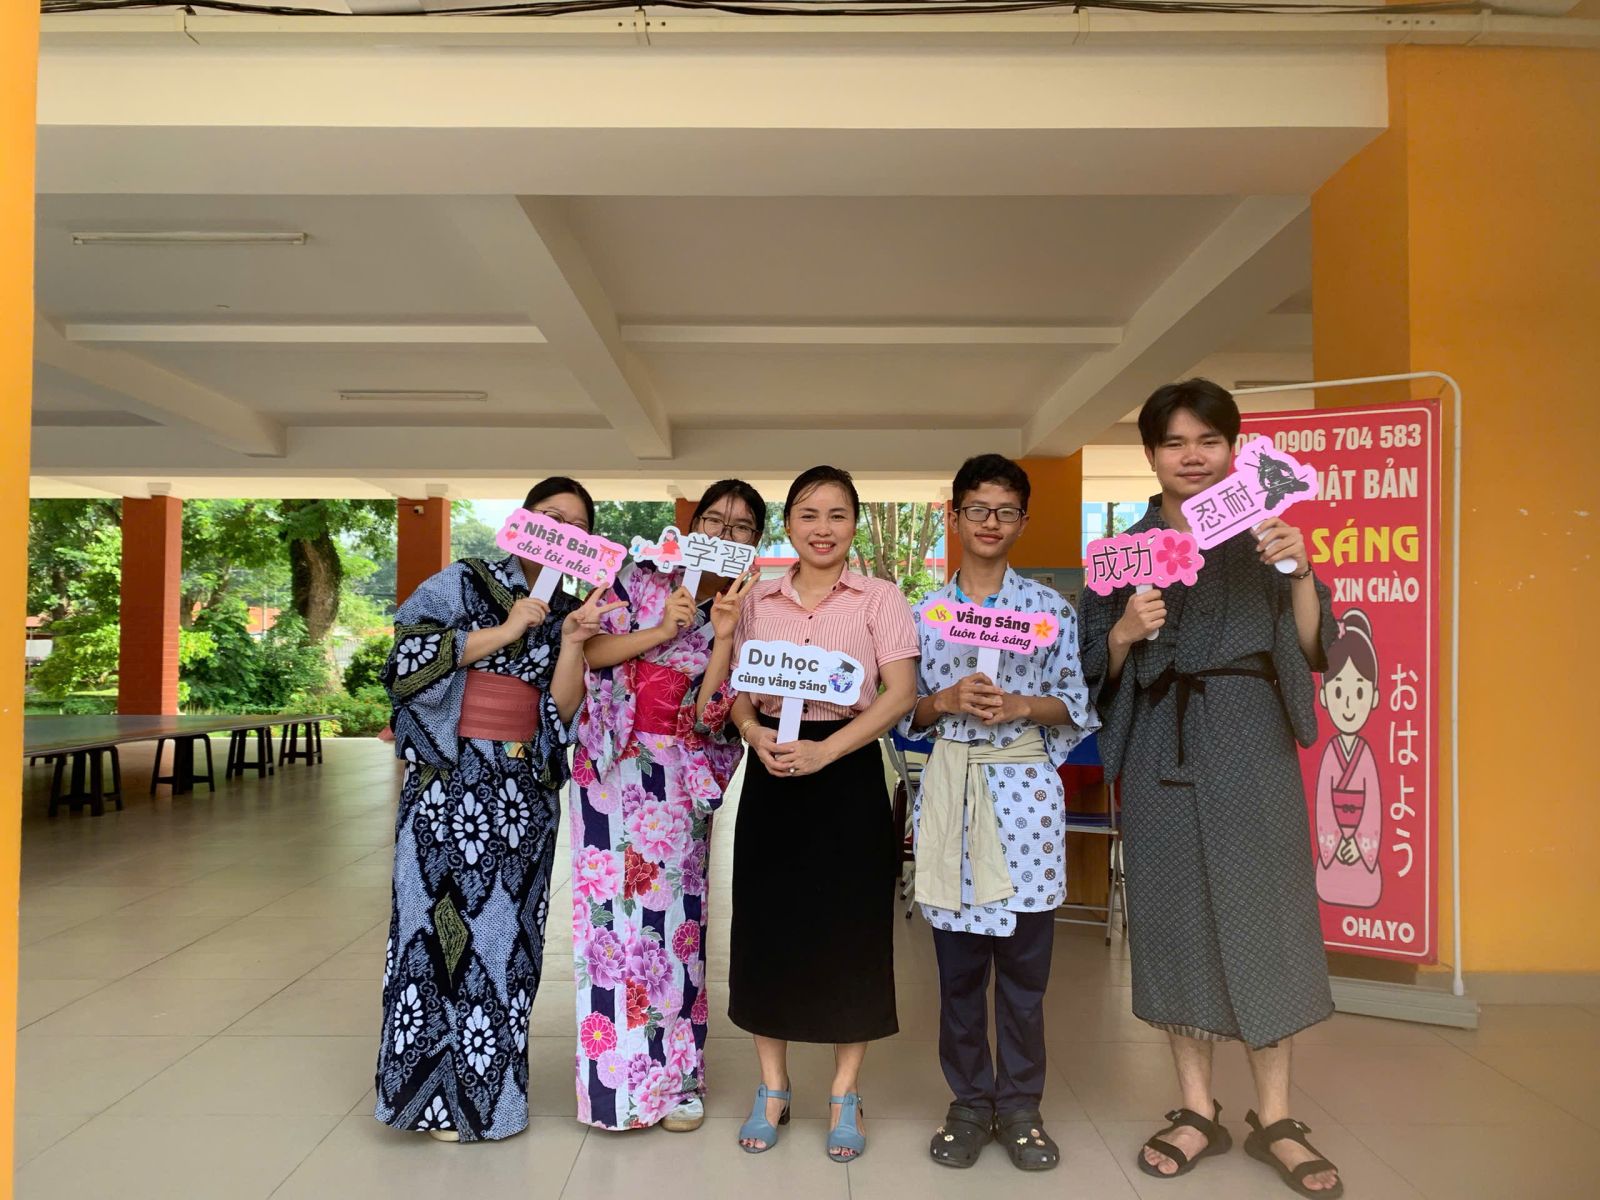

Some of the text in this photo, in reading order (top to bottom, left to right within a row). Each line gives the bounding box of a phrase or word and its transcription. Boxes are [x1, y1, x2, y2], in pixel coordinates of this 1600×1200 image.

[1275, 429, 1326, 453] 0906
[1332, 427, 1373, 450] 704
[1380, 424, 1421, 448] 583
[1363, 458, 1418, 499] BẢN
[1191, 480, 1255, 532] 忍耐
[524, 521, 598, 559] Nhật Bản
[685, 536, 752, 575] 学習
[1311, 518, 1419, 567] SÁNG
[517, 541, 591, 575] chờ tôi nhé
[1092, 541, 1153, 583] 成功
[1333, 570, 1420, 603] XIN CHÀO
[956, 607, 1030, 633] Vầng Sáng
[949, 626, 976, 639] luôn
[1002, 635, 1031, 650] sáng
[748, 648, 819, 675] Du học
[738, 672, 765, 686] cùng
[799, 680, 827, 694] Sáng
[1389, 663, 1419, 877] おはよう
[1342, 916, 1415, 943] OHAYO
